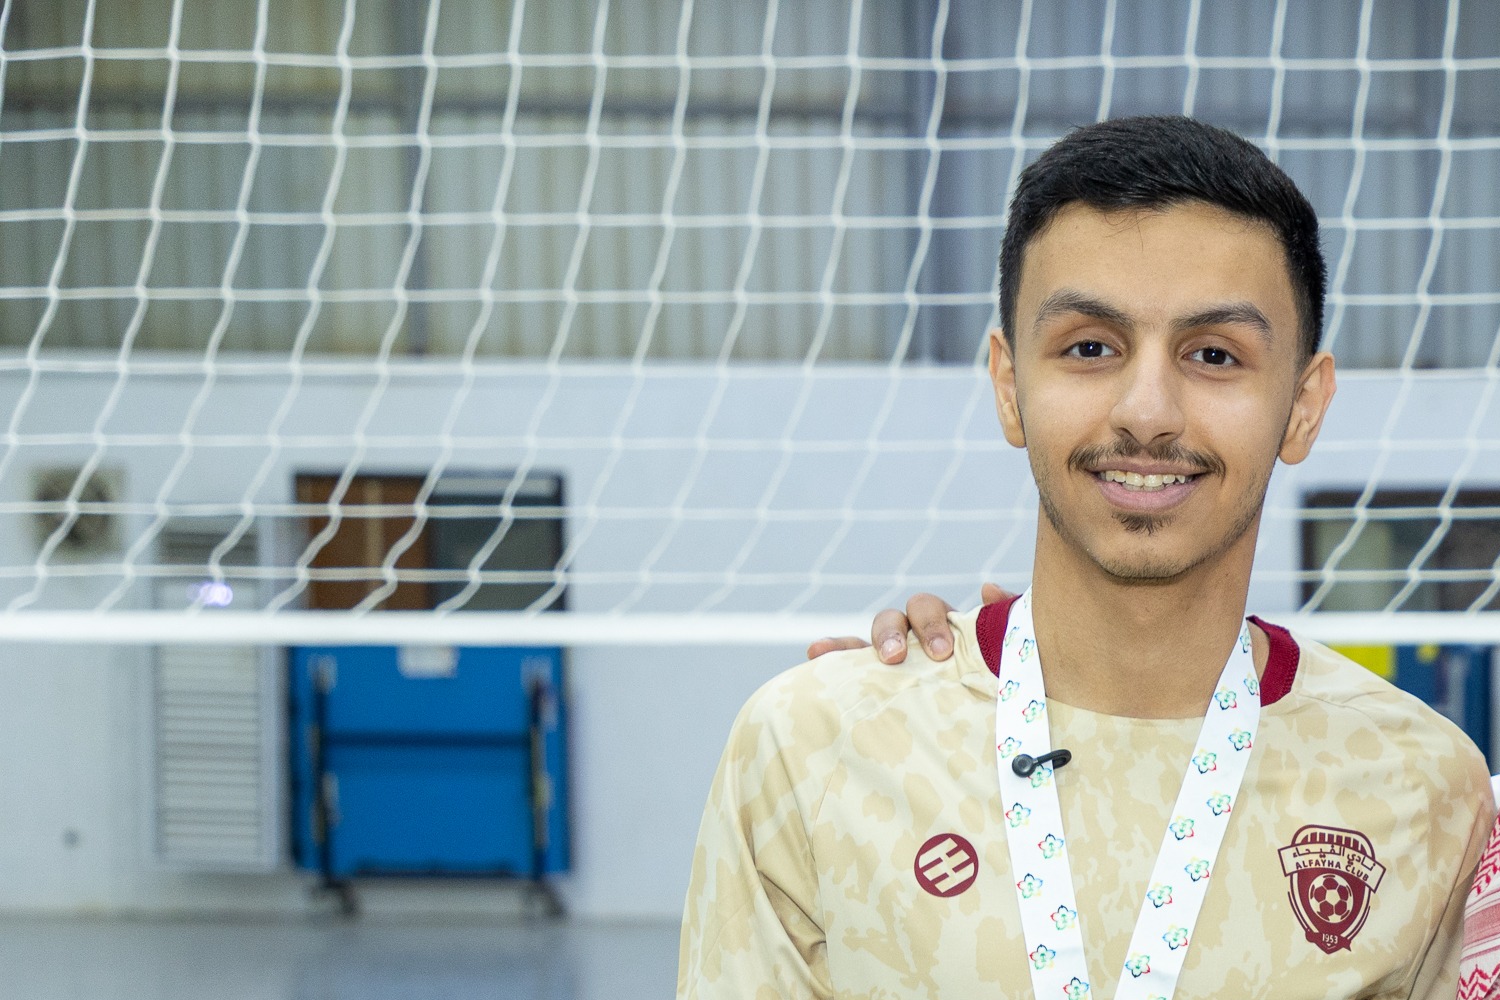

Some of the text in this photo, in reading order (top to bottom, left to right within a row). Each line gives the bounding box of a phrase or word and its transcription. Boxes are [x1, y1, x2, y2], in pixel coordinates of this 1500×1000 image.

[1293, 844, 1376, 871] نادي الفيحاء
[1296, 859, 1369, 882] ALFAYHA CLUB
[1322, 933, 1338, 944] 1953
